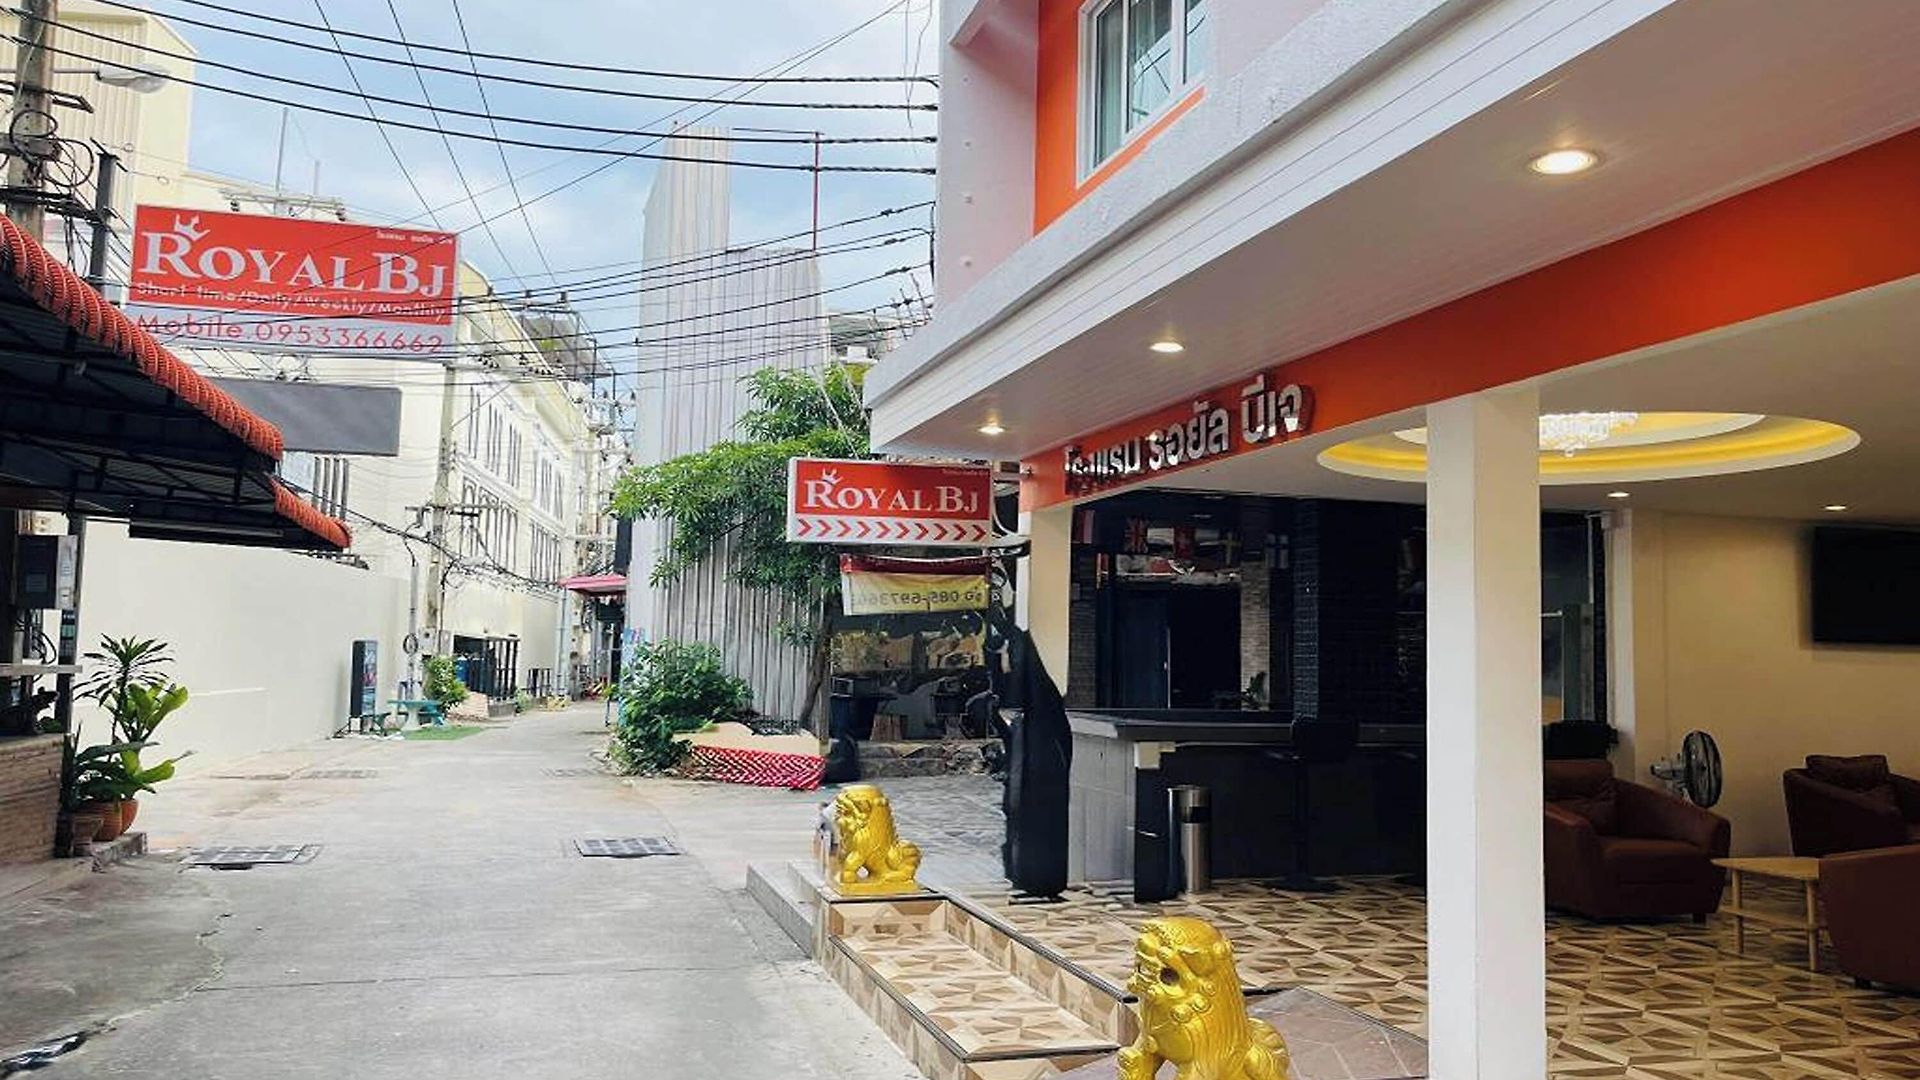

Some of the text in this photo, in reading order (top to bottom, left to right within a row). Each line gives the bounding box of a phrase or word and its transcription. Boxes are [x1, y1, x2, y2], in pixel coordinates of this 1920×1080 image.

[140, 231, 364, 291] ROYAL
[1146, 400, 1230, 471] รอยัล
[803, 479, 932, 512] ROYAL
